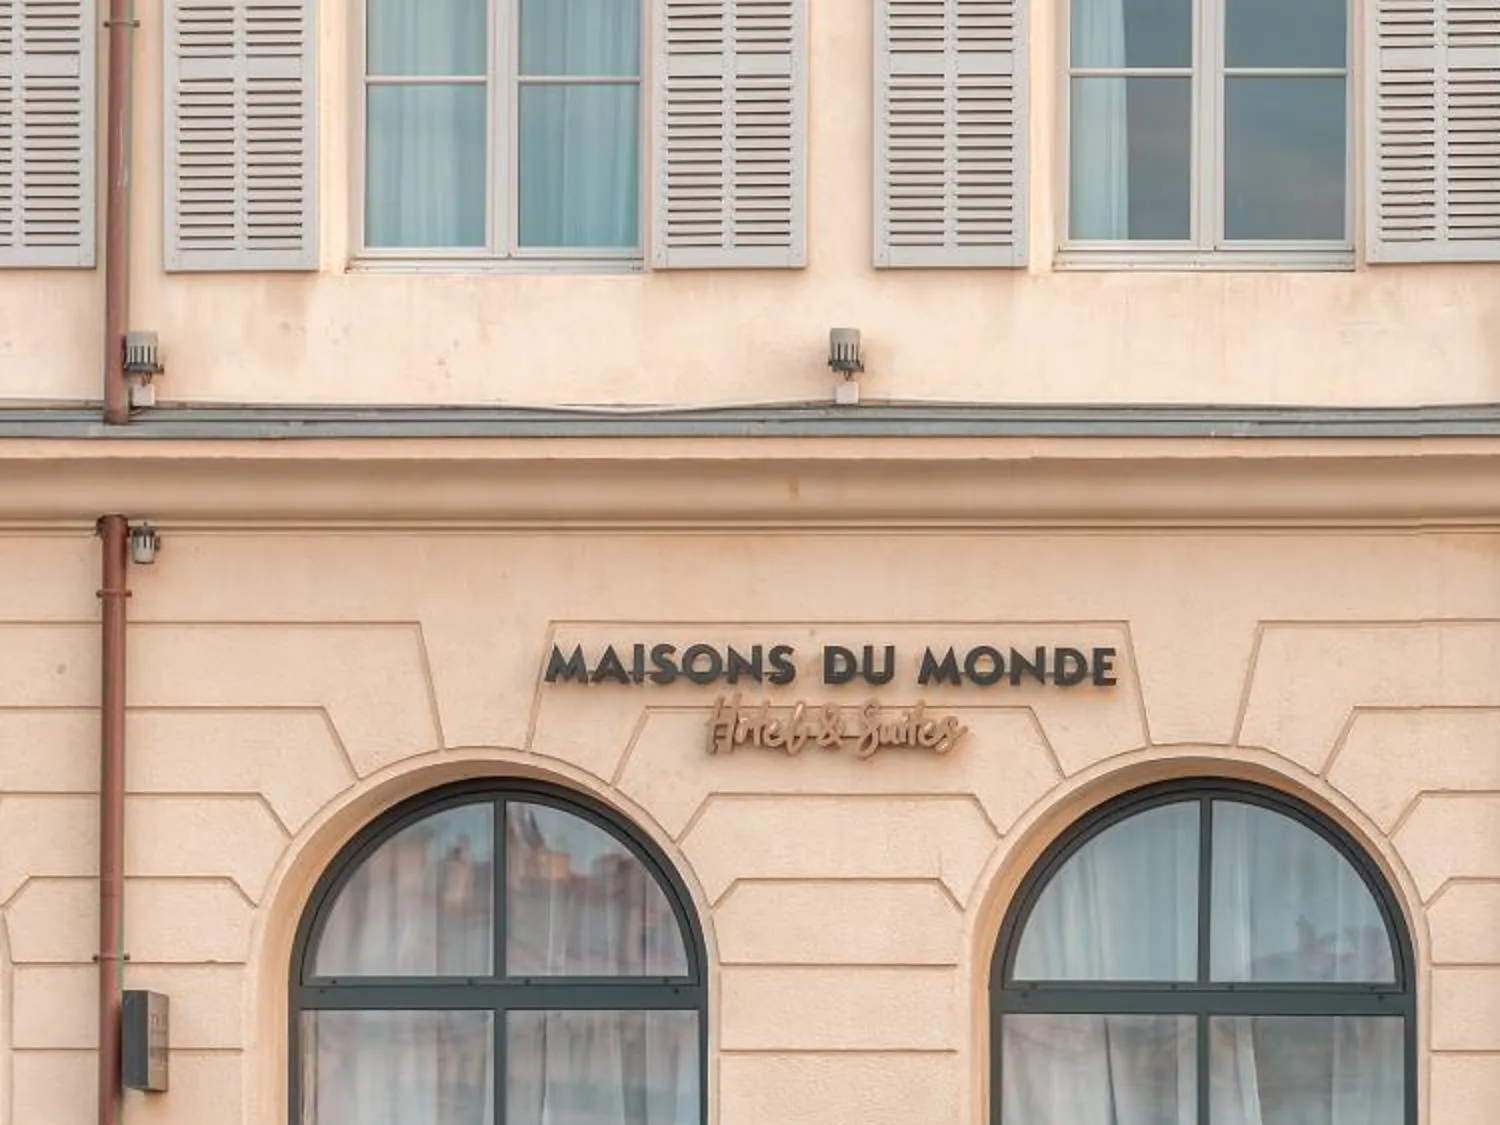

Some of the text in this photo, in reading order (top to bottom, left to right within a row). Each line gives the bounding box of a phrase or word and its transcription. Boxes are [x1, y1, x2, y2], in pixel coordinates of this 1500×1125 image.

[545, 643, 1117, 686] MAISONS DU MONDE
[817, 702, 847, 749] &
[854, 700, 968, 760] Suites
